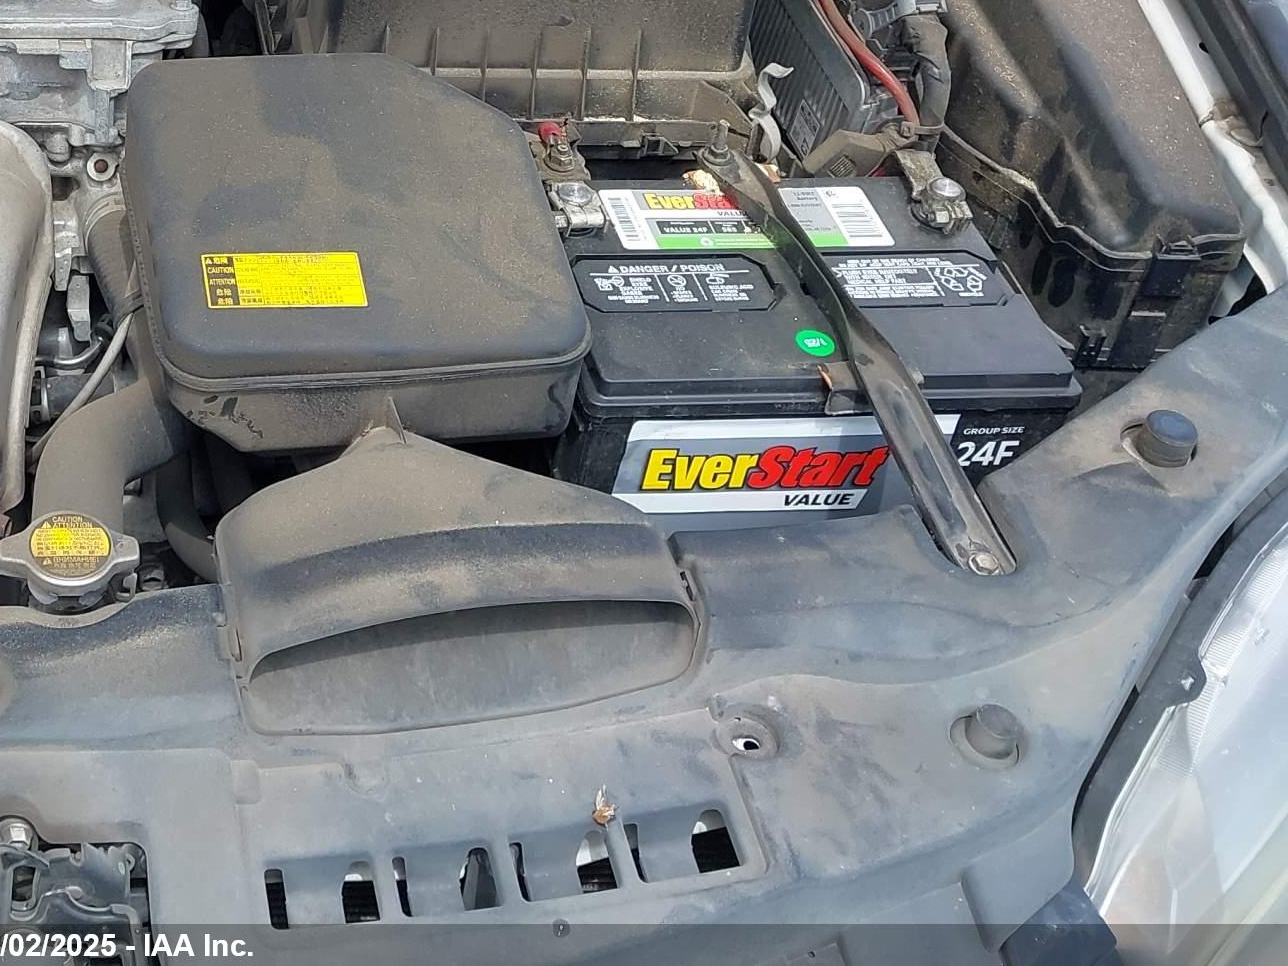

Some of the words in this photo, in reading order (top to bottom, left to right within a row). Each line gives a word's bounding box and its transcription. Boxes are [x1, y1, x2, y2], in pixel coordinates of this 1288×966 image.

[642, 193, 739, 210] EverSta
[207, 266, 234, 274] CAUTION
[619, 265, 669, 273] DANGER
[679, 264, 725, 272] POISON
[209, 278, 236, 286] ATTENTION
[963, 426, 999, 435] GROUP
[1000, 426, 1025, 434] SIZE
[957, 440, 1020, 467] 24F
[639, 445, 890, 491] EverStart
[783, 493, 852, 507] VALUE
